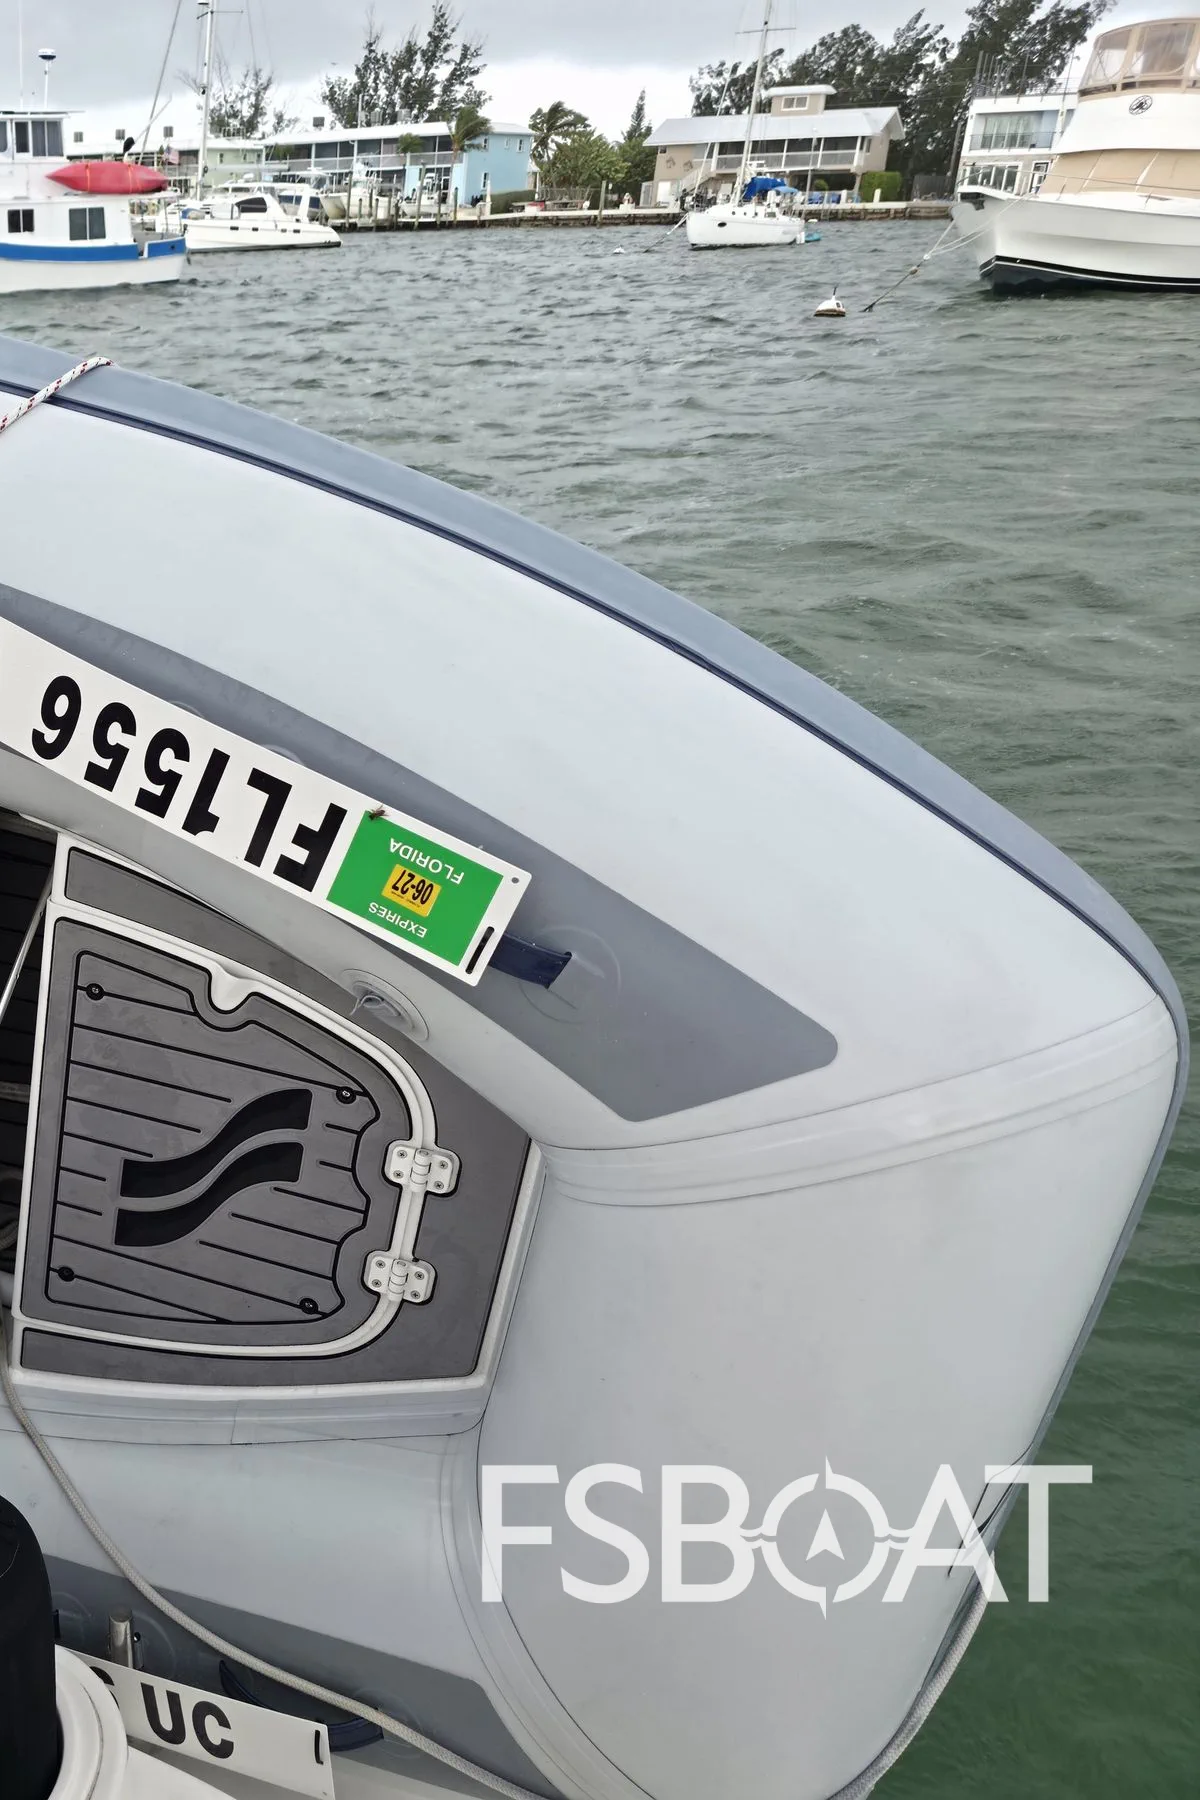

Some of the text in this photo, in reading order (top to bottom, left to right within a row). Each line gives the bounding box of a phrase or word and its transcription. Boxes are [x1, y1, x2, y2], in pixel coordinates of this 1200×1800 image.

[389, 837, 465, 885] FLORIDA
[391, 869, 434, 905] 06-27
[368, 901, 428, 938] EXPIRES
[141, 1682, 234, 1760] UC
